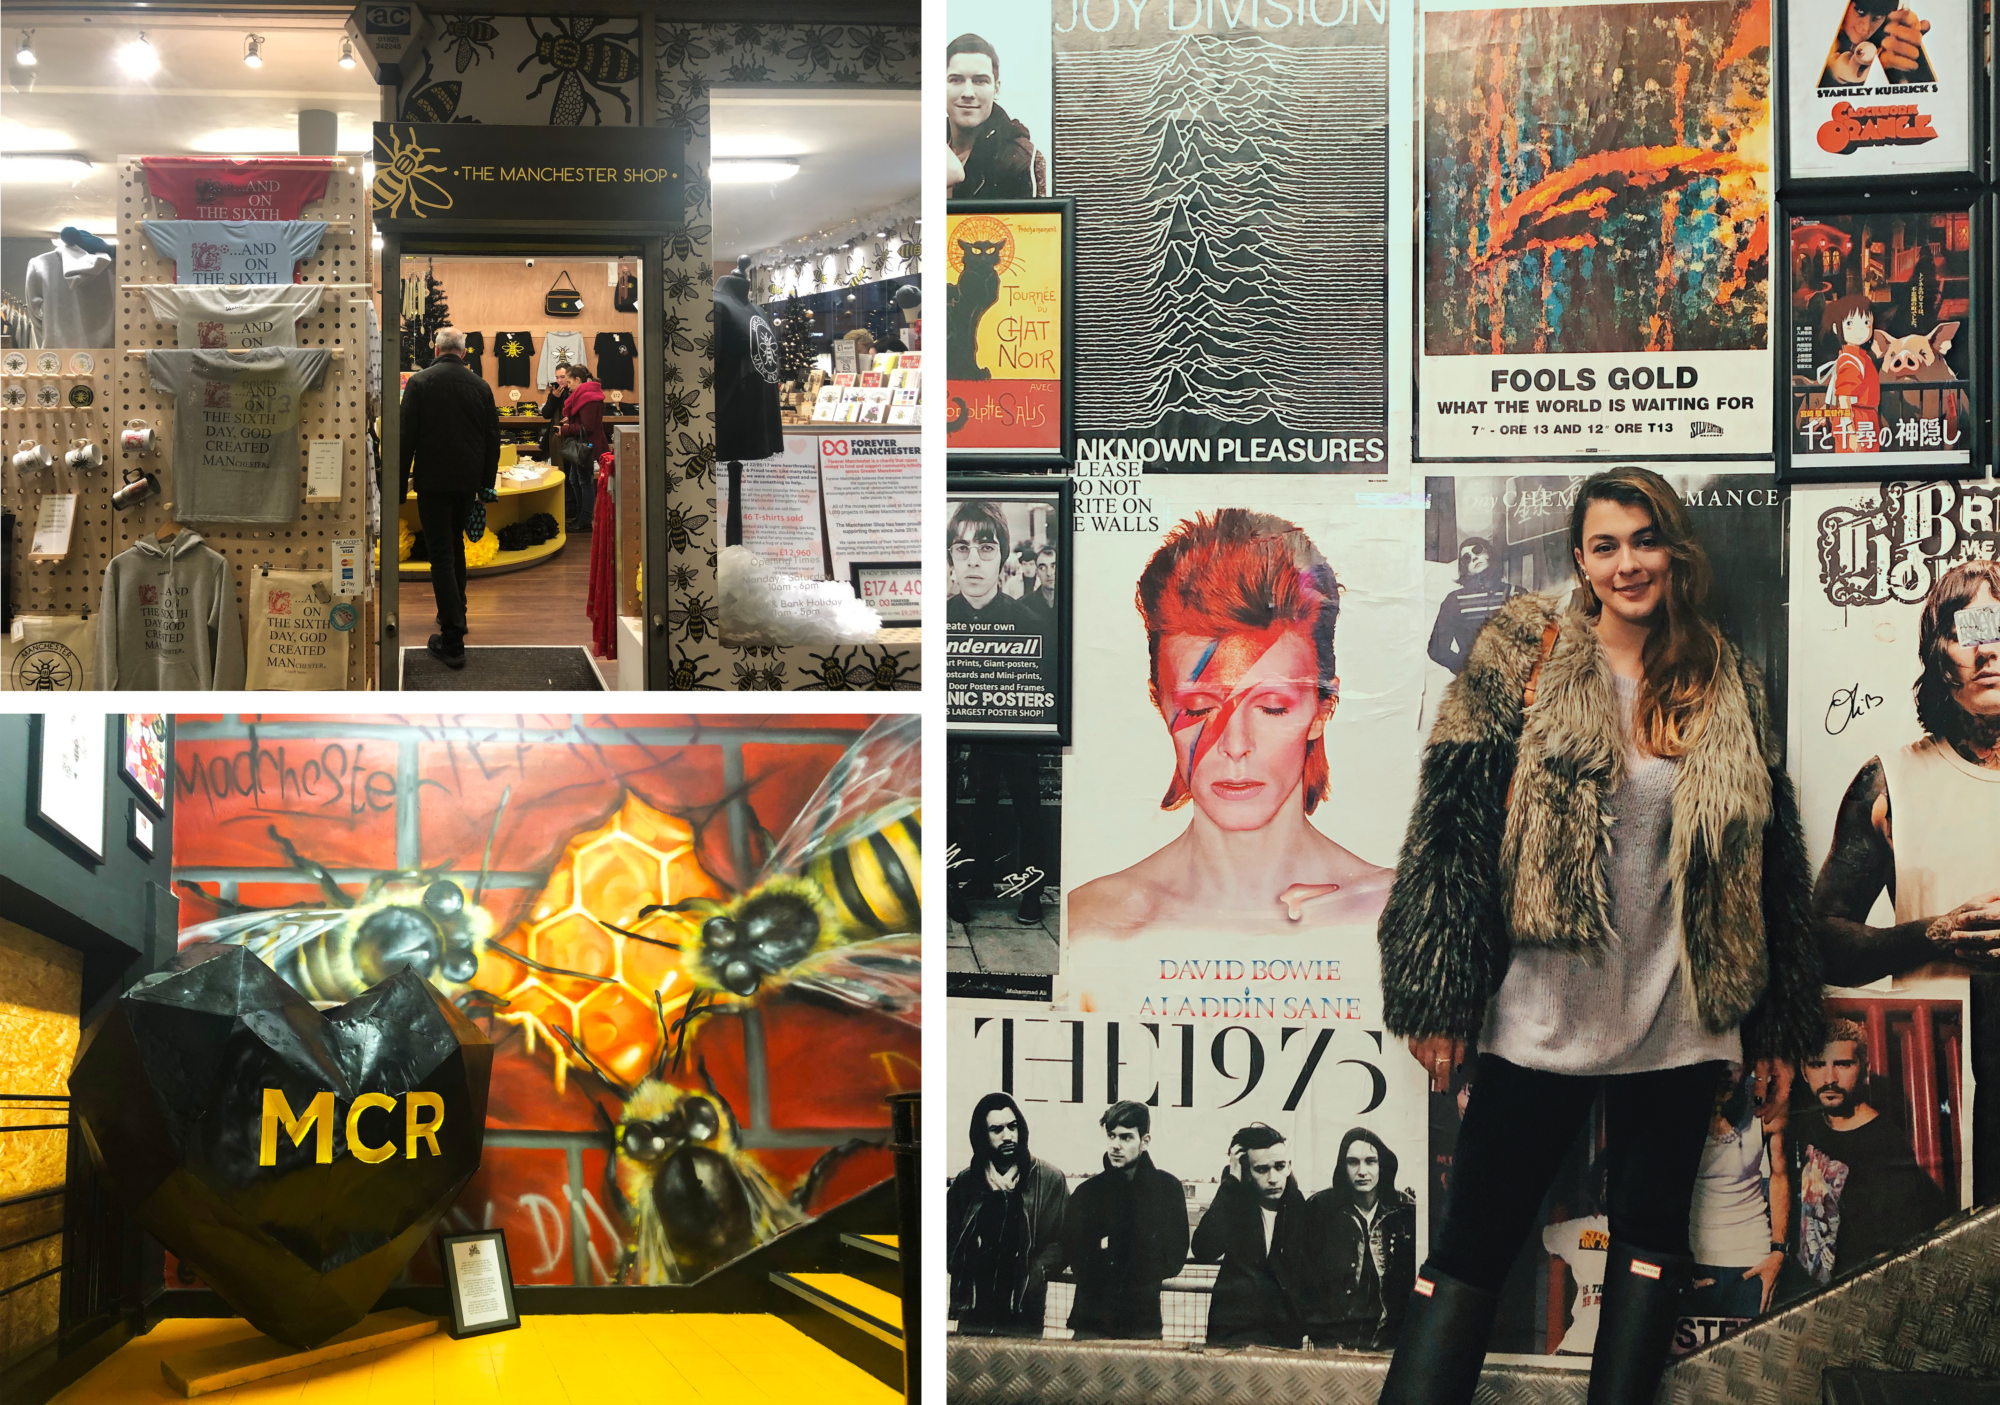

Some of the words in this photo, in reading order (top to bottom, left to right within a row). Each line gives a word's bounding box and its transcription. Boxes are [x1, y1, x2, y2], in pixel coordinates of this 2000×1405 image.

[373, 8, 405, 25] ac
[1055, 0, 1143, 32] JOY
[1169, 0, 1385, 30] DIVISION
[1817, 87, 1873, 98] STANLEY
[1831, 101, 1919, 122] CLOCKWORK
[1816, 114, 1939, 154] ORANGE
[462, 166, 495, 181] THE
[500, 167, 617, 182] MANCHESTER
[623, 168, 668, 183] SHOP
[248, 194, 272, 206] ON
[197, 207, 229, 219] THE
[232, 208, 280, 220] SIXTH
[1018, 224, 1058, 234] Prochainement
[230, 243, 276, 255] ...AND
[245, 258, 269, 270] ON
[193, 272, 225, 284] THE
[229, 272, 277, 284] SIXTH
[230, 322, 273, 334] ...AND
[997, 315, 1050, 347] CHAT
[241, 337, 263, 348] ON
[998, 344, 1055, 373] NOIR
[1491, 368, 1596, 392] FOOLS
[1608, 366, 1698, 390] GOLD
[1030, 383, 1053, 392] AVEC
[245, 400, 265, 411] ON
[1438, 401, 1488, 414] WHAT
[1494, 400, 1529, 413] THE
[1536, 400, 1601, 413] WORLD
[1609, 399, 1625, 412] IS
[1632, 398, 1709, 411] WAITING
[1717, 397, 1754, 410] FOR
[203, 411, 231, 422] THE
[234, 413, 276, 424] SIXTH
[206, 426, 237, 439] DAY,
[240, 427, 272, 439] GOD
[1500, 425, 1527, 435] ORE
[1533, 425, 1549, 434] 13
[1553, 424, 1582, 434] AND
[1614, 423, 1643, 434] ORE
[1649, 422, 1674, 433] T13
[1800, 418, 1961, 450] 千と千尋の神隠し
[205, 440, 270, 454] CREATED
[851, 439, 897, 447] FOREVER
[852, 447, 921, 455] MANCHESTER
[1076, 438, 1210, 462] NKNOWN
[1218, 438, 1385, 463] PLEASURES
[1076, 462, 1140, 477] LEASE
[1098, 480, 1141, 495] NOT
[1503, 490, 1576, 507] CHEM
[1684, 489, 1780, 506] MANCE
[1073, 498, 1117, 513] RITE
[1123, 498, 1153, 513] ON
[755, 513, 784, 521] T-shirts
[787, 514, 803, 522] sold
[1091, 516, 1159, 532] WALLS
[779, 549, 811, 558] £12,960
[794, 556, 820, 564] Times
[788, 573, 831, 582] Saturday
[768, 583, 791, 591] 10am
[806, 598, 842, 607] Holiday
[303, 607, 321, 617] ON
[267, 617, 291, 628] THE
[294, 618, 331, 629] SIXTH
[969, 623, 991, 632] your
[270, 630, 297, 643] DAY,
[299, 632, 327, 643] GOD
[21, 643, 72, 659] MANCHESTER
[269, 643, 326, 655] CREATED
[946, 638, 1039, 654] nderwall
[957, 660, 982, 668] Prints,
[983, 660, 1039, 669] Giant-posters,
[996, 672, 1042, 681] Mini-prints,
[948, 682, 967, 690] Door
[1000, 683, 1015, 691] and
[1016, 683, 1045, 691] Frames
[946, 691, 978, 706] NIC
[982, 692, 1055, 707] POSTERS
[951, 708, 986, 716] LARGEST
[1019, 709, 1044, 717] SHOP!
[1159, 959, 1245, 980] DAVID
[1251, 960, 1342, 981] BOWIE
[1006, 988, 1038, 996] Muhammad
[1139, 992, 1275, 1018] ALADDIN
[1283, 997, 1362, 1020] SANE
[975, 1018, 1159, 1106] THE
[1171, 1023, 1387, 1114] 1975
[260, 1088, 445, 1167] MCR
